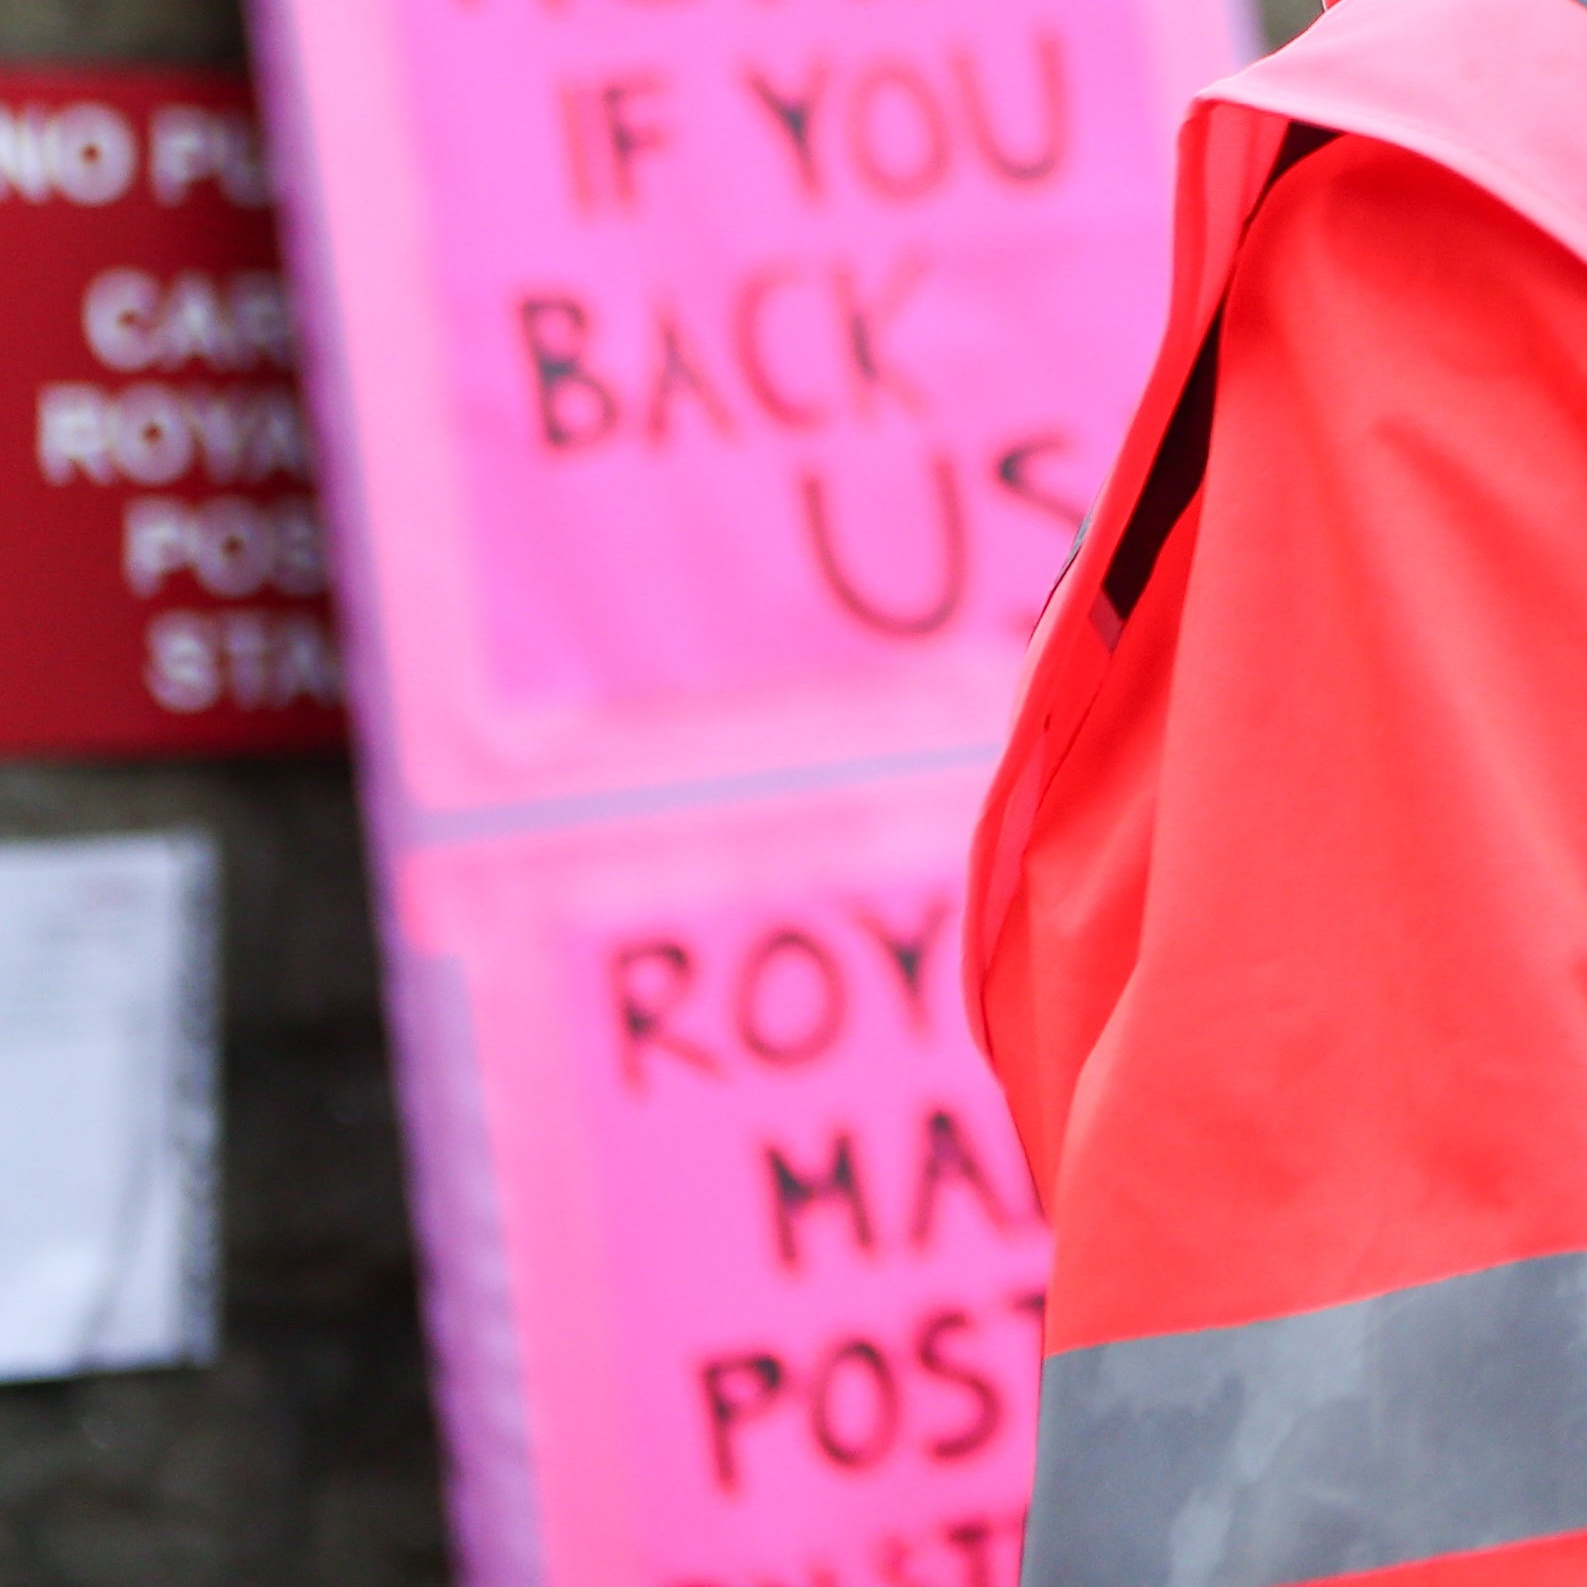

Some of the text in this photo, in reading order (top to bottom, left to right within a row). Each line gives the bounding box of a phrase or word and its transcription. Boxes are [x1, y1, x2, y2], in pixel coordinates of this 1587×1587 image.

[0, 102, 136, 205] NO
[560, 26, 1069, 216] IF YOU
[517, 252, 930, 450] BACK
[611, 896, 953, 1095] ROY
[762, 1108, 1008, 1272] MA
